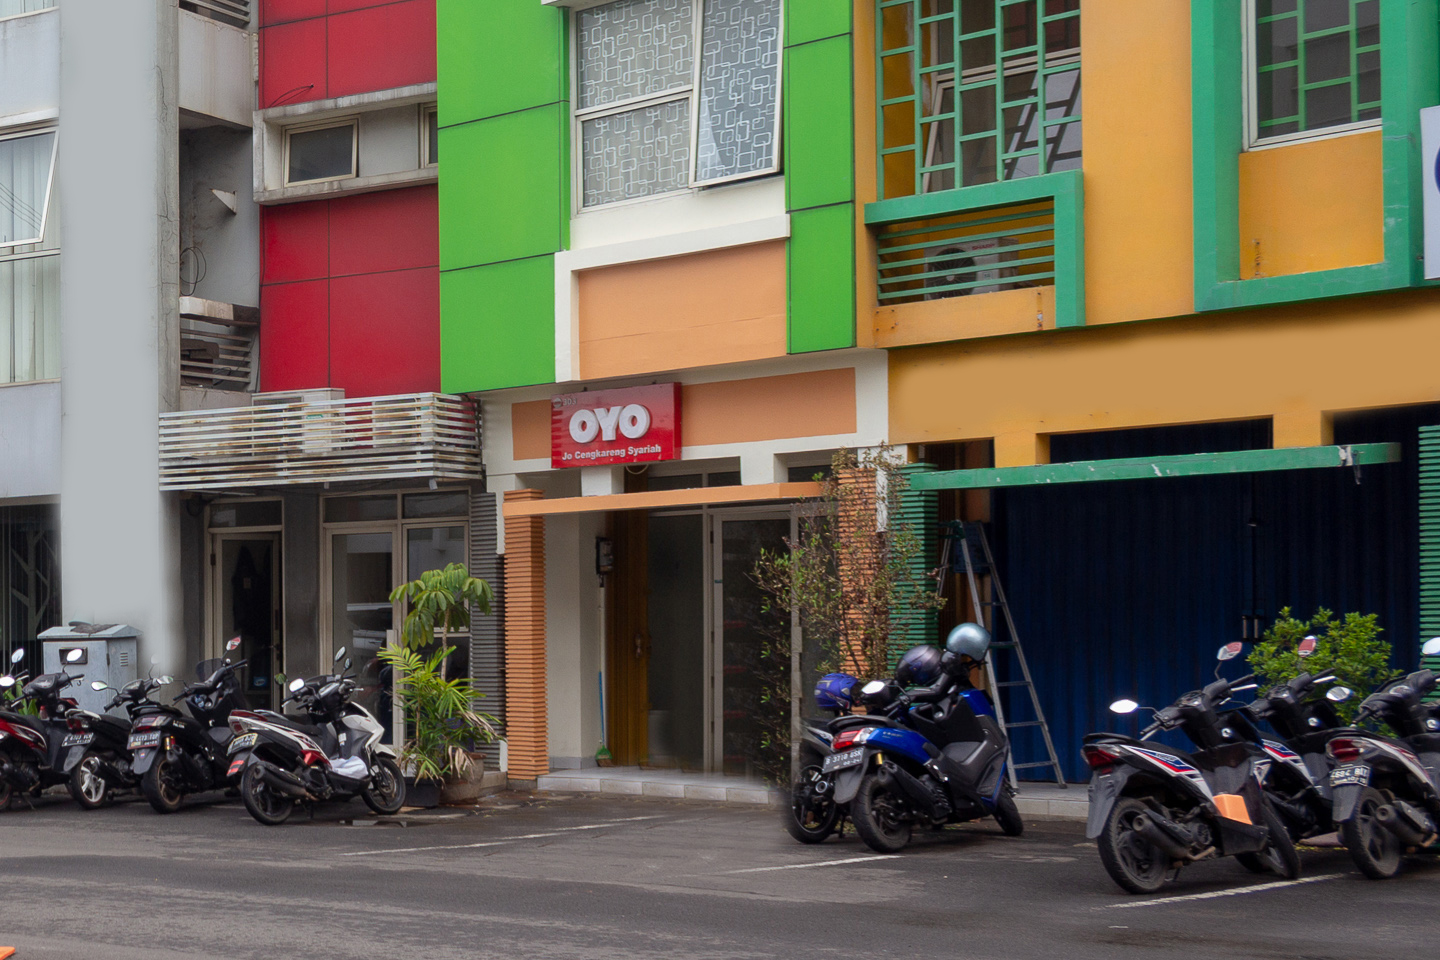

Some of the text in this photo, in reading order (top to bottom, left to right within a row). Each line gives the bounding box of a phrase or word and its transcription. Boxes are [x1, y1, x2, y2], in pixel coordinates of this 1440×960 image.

[568, 403, 651, 444] OYO
[562, 444, 662, 461] Jo Cengkareng Syariah
